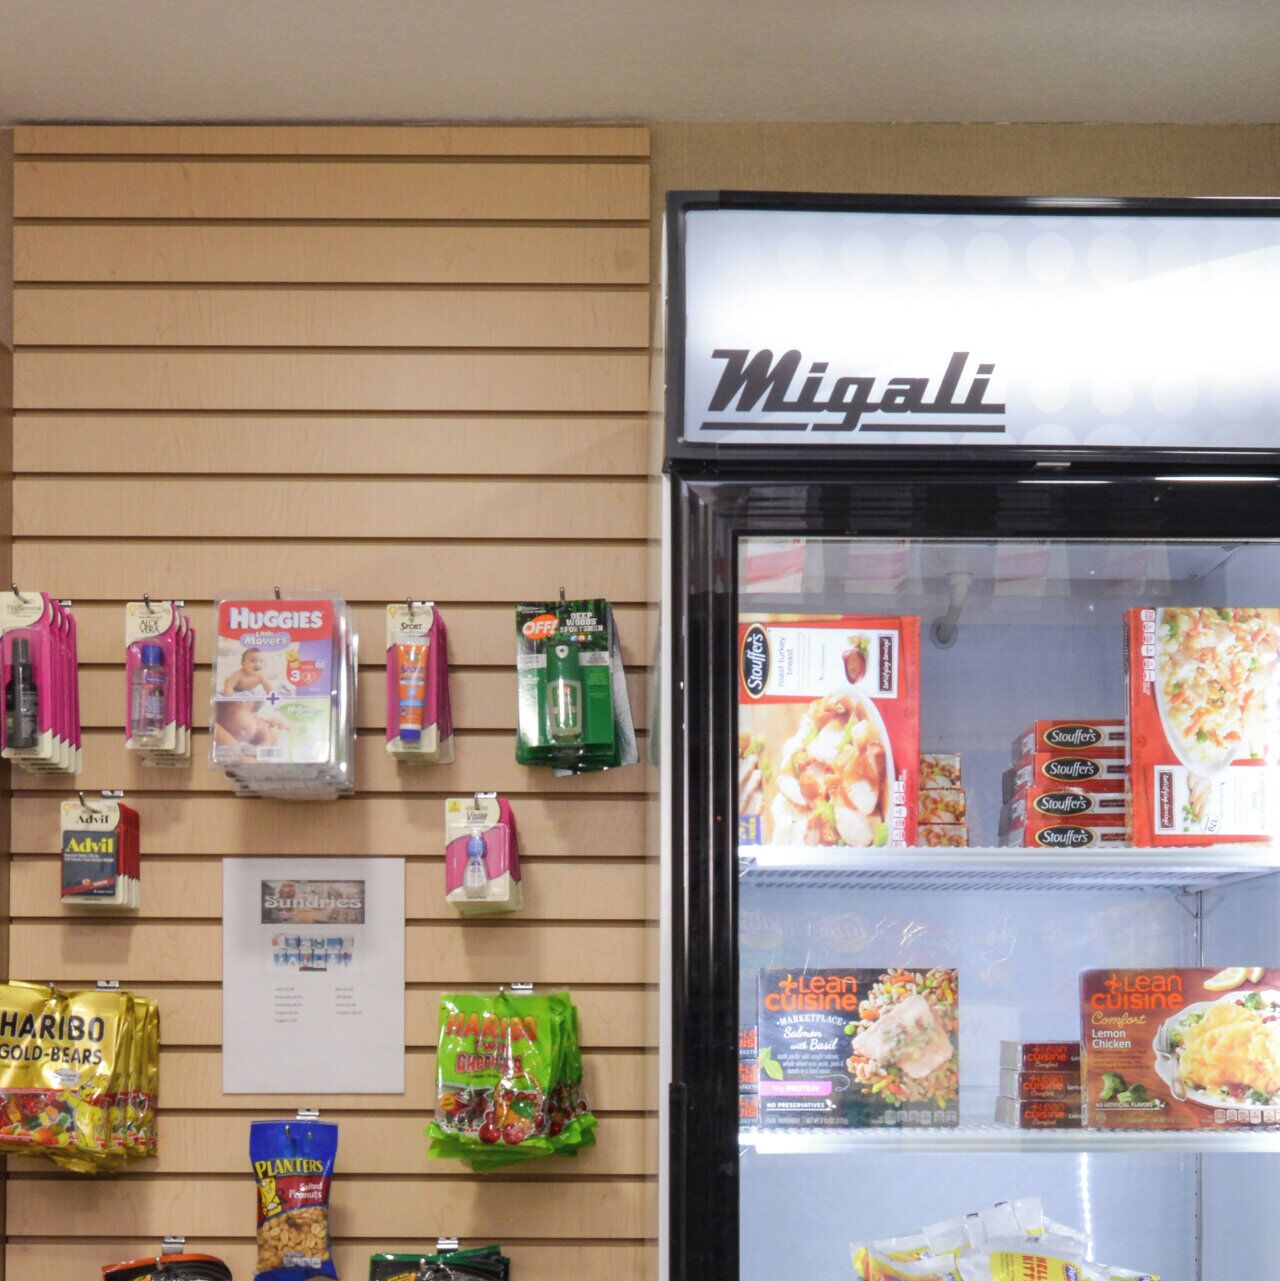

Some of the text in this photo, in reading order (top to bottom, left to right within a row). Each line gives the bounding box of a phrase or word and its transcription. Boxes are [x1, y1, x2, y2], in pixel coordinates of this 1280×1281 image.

[707, 348, 1006, 432] Migali
[140, 619, 159, 627] ALOE
[229, 607, 324, 629] HUGGIES
[566, 618, 597, 626] WOODS
[139, 625, 160, 633] VERA
[522, 620, 559, 636] OFF!
[779, 636, 787, 662] turkey
[747, 633, 766, 690] Stouffer's
[1051, 729, 1096, 744] Stouffer's
[1049, 761, 1094, 777] Stouffer's
[1041, 795, 1087, 811] Stouffer's
[76, 815, 109, 824] Advil
[1042, 829, 1088, 845] Stouffer's
[65, 838, 113, 853] Advil
[264, 895, 362, 909] Sundries
[799, 976, 857, 993] Lean
[1125, 975, 1183, 992] Lean
[1091, 992, 1184, 1009] cuisine
[0, 1011, 104, 1042] HARIBO
[779, 1014, 843, 1026] MARKETPLACE
[1092, 1011, 1146, 1027] Comfort
[783, 1026, 822, 1038] Salmon
[1092, 1029, 1126, 1038] Lemon
[810, 1038, 837, 1051] Basil
[1092, 1039, 1131, 1048] Chicken
[256, 1158, 323, 1178] PLANTERS
[299, 1182, 322, 1190] Salted
[289, 1190, 321, 1199] Peanuts
